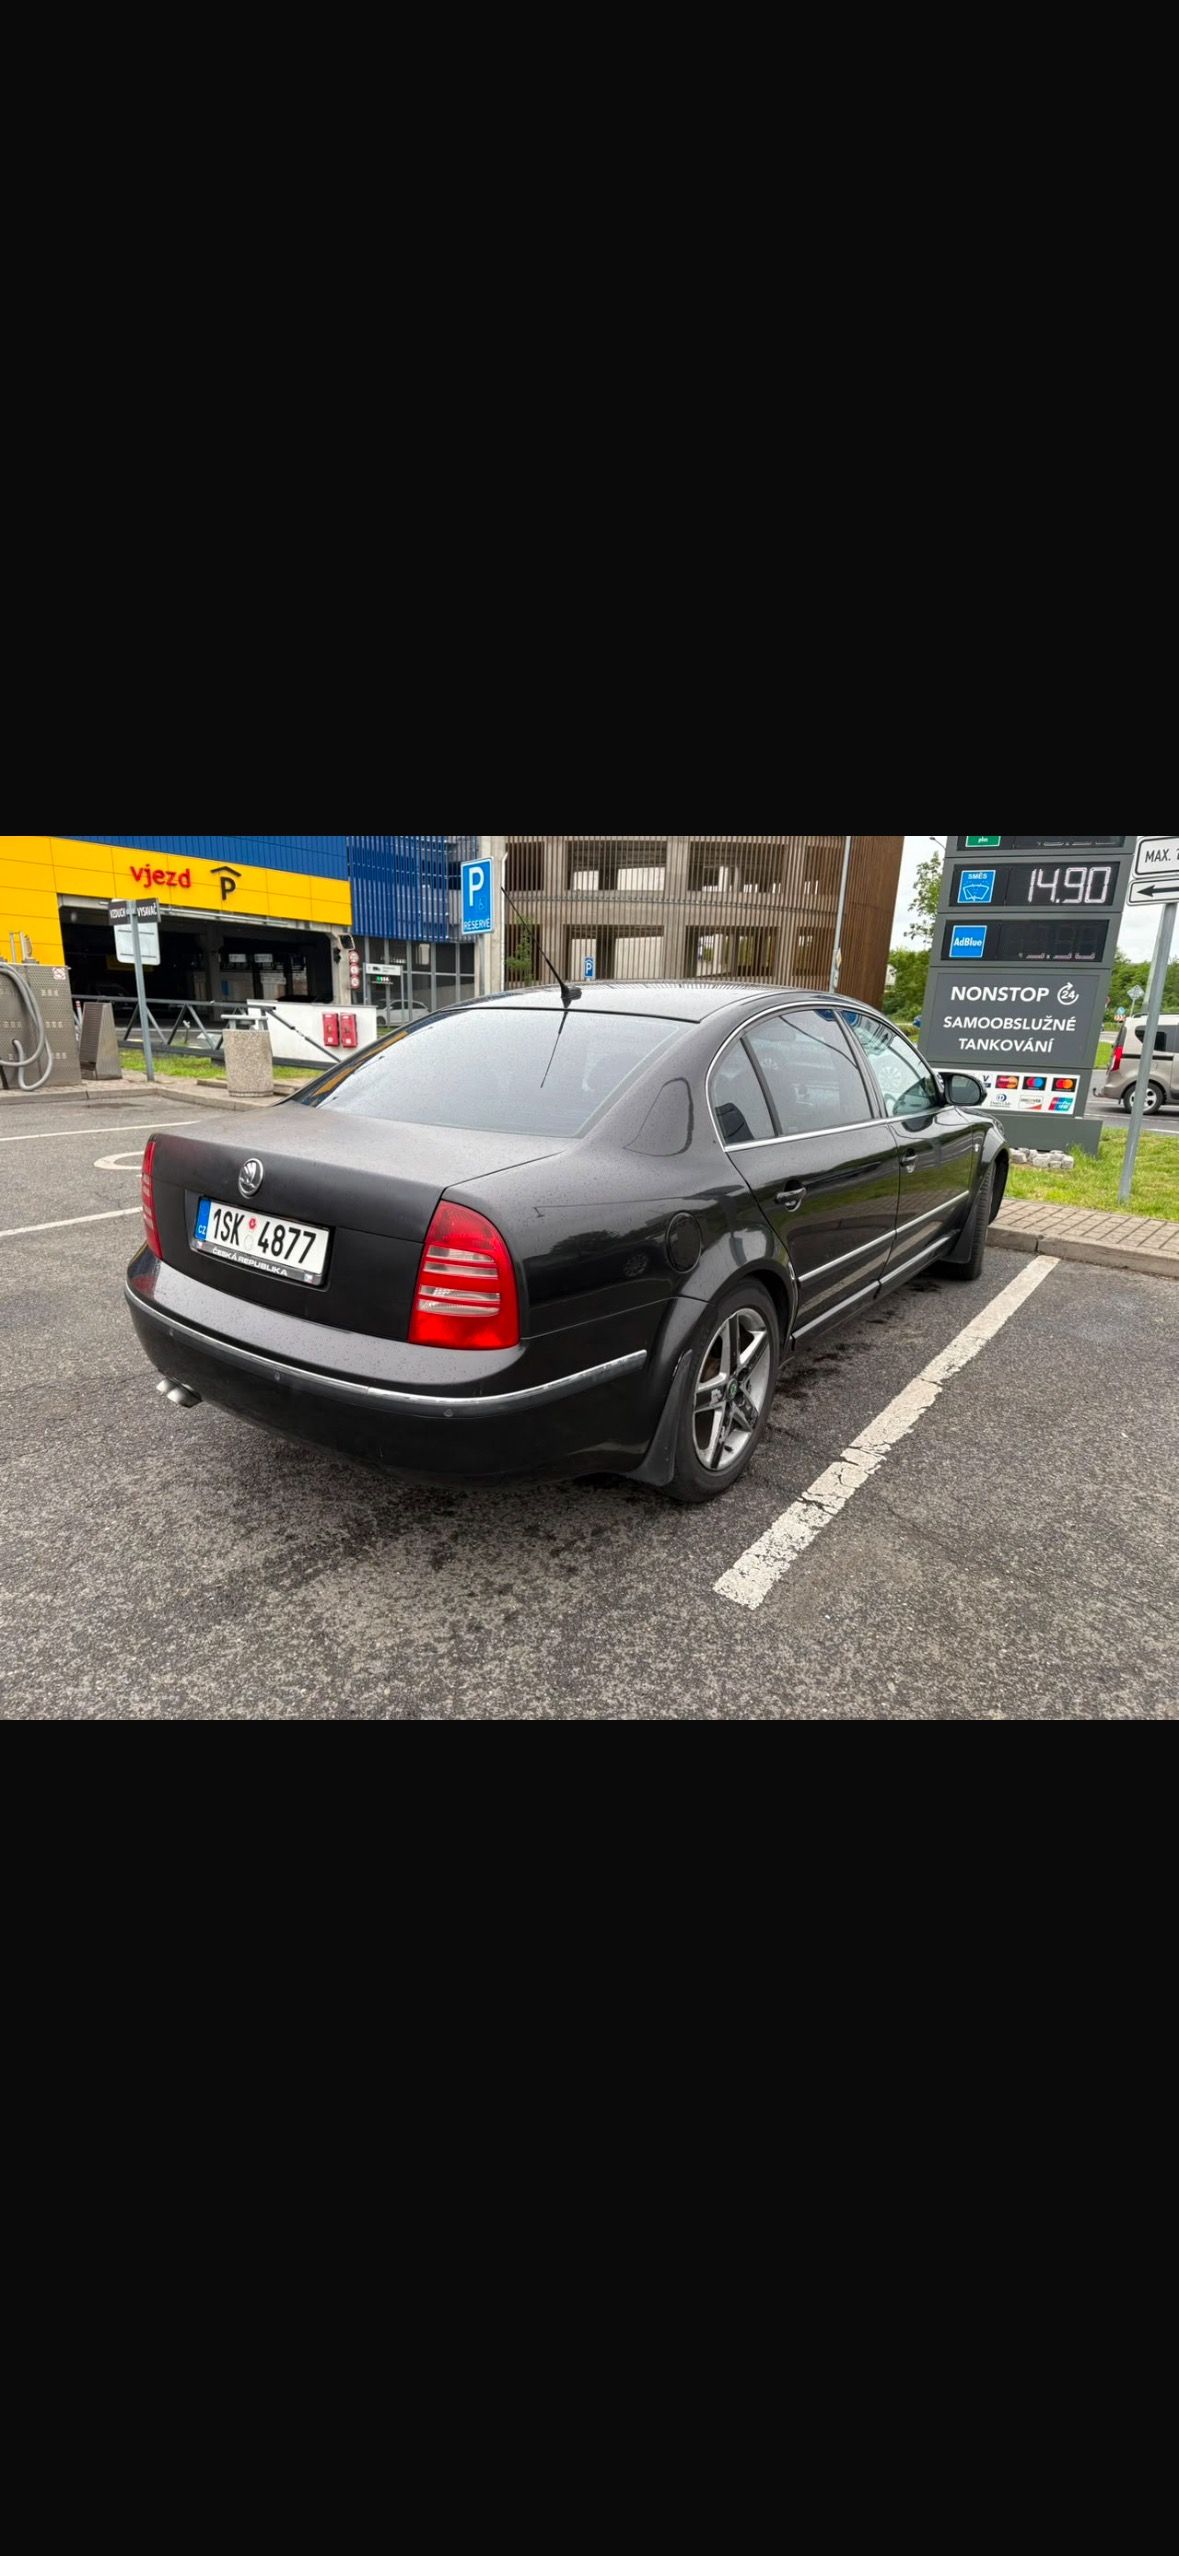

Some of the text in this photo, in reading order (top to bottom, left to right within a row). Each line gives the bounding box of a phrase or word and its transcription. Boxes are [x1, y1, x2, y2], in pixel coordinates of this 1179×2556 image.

[1145, 848, 1171, 863] MAX.
[130, 864, 236, 900] vjezd P
[968, 872, 988, 880] SMĚS
[468, 866, 484, 906] P
[1028, 867, 1111, 904] 14.90
[953, 936, 983, 948] AdBlue
[951, 985, 1076, 1003] NONSTOP 24
[943, 1013, 1077, 1032] SAMOOBSLUŽNÉ
[958, 1036, 1053, 1053] TANKOVÁNÍ
[198, 1224, 206, 1235] CZ
[213, 1208, 316, 1264] 1SK 4877
[212, 1246, 288, 1276] ČESKÁ REPUBLIKA
